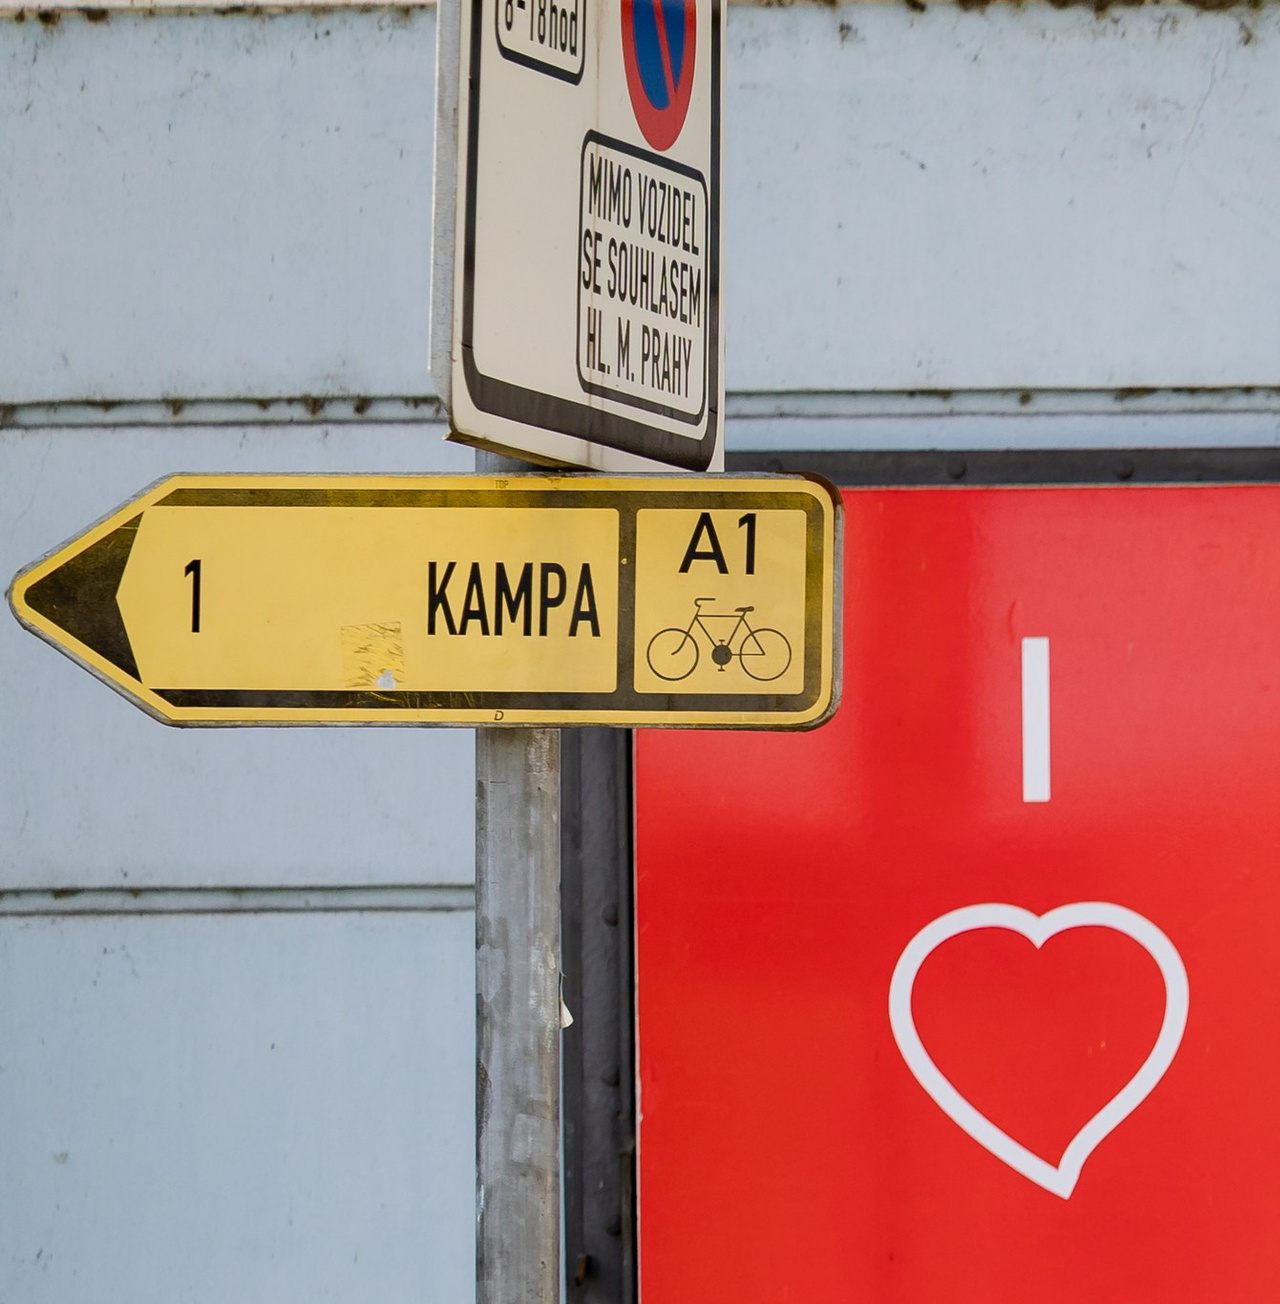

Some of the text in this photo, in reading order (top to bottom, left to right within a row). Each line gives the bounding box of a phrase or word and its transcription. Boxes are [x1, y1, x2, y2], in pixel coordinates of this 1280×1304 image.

[588, 153, 699, 256] MIMO VOZIDEL
[582, 229, 701, 328] SE SOUHLASEM
[586, 306, 692, 398] HL. M. PRAHY
[679, 513, 757, 576] A1
[183, 559, 202, 634] 1
[427, 561, 601, 638] KAMPA
[1021, 636, 1051, 803] I
